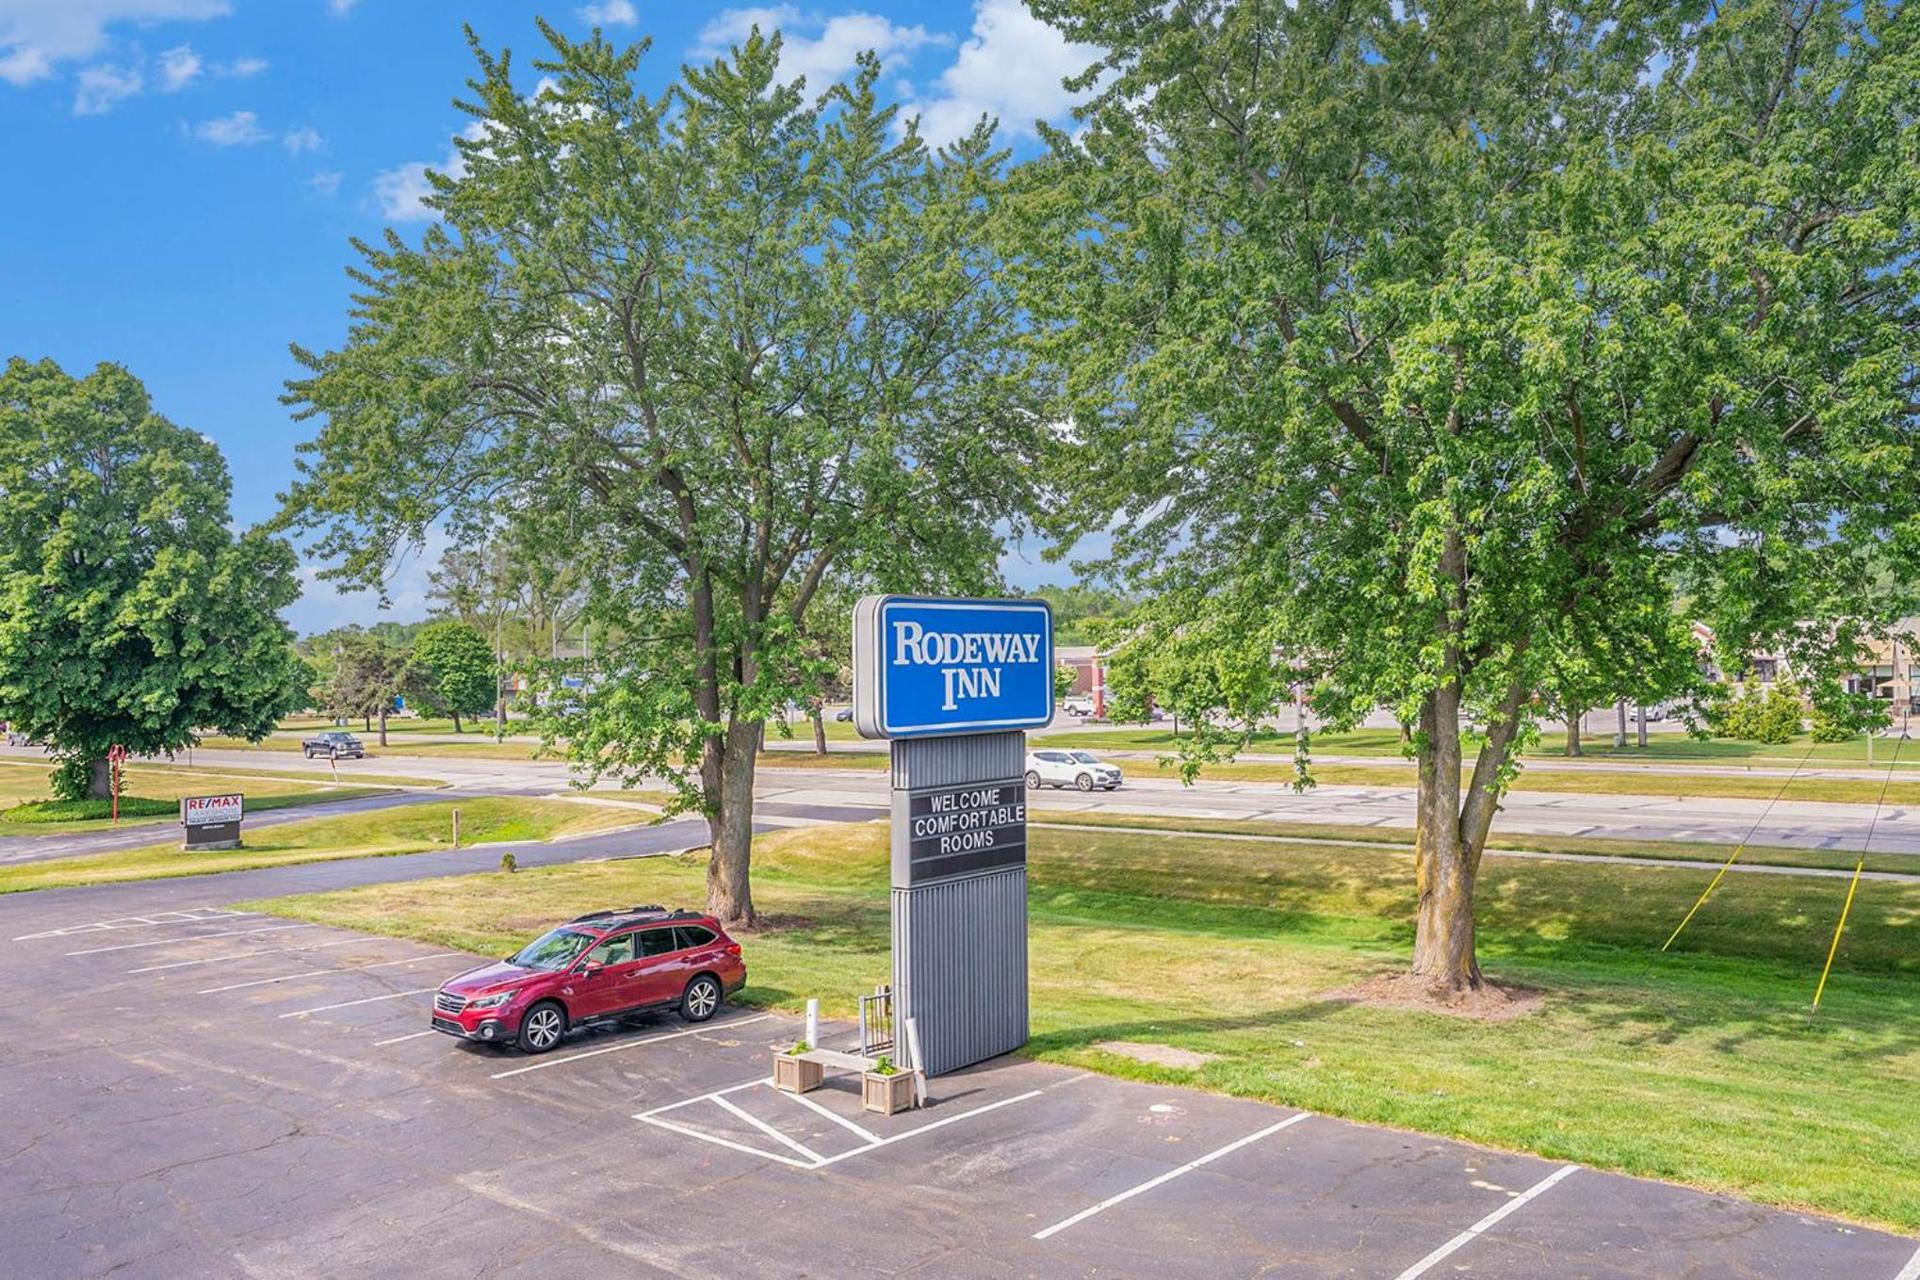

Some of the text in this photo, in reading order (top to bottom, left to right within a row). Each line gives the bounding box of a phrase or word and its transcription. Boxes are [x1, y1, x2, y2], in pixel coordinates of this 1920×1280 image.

[893, 621, 1040, 665] RODEWAY
[941, 668, 1001, 711] INN
[189, 796, 239, 810] RE/MAX
[931, 789, 1000, 813] WELCOME
[915, 805, 1025, 837] COMFORTABLE
[940, 830, 994, 854] ROOMS
